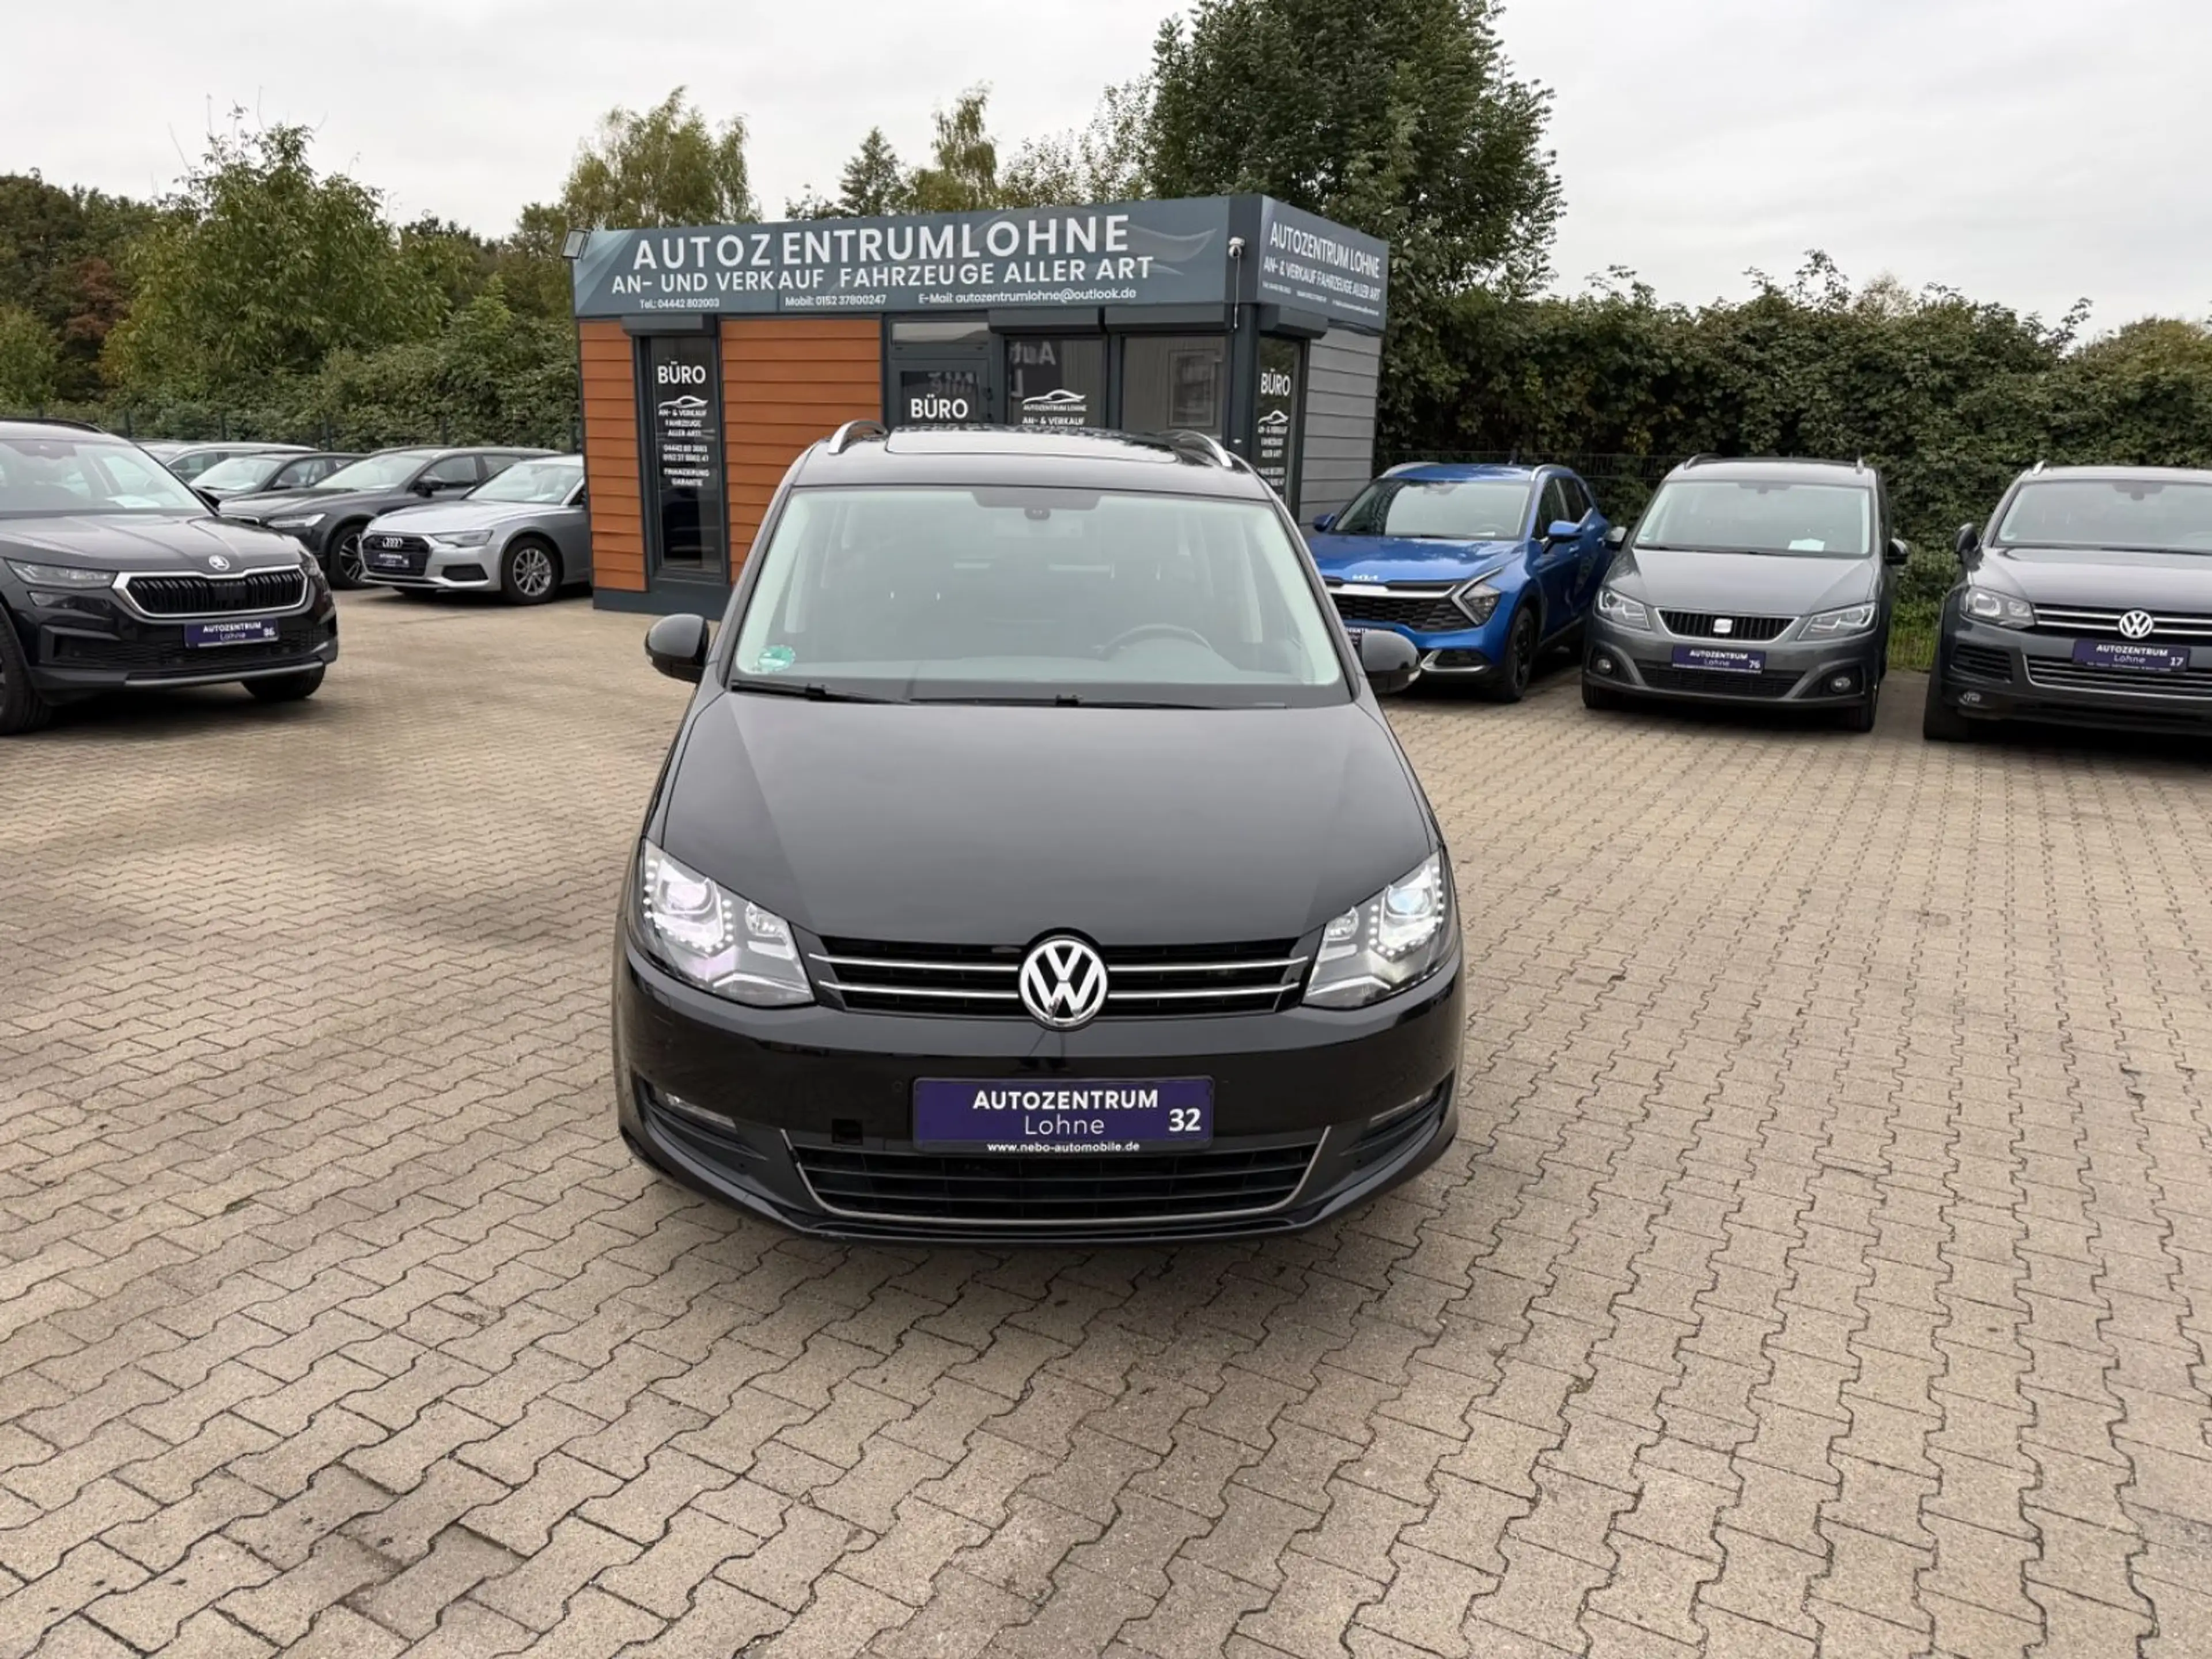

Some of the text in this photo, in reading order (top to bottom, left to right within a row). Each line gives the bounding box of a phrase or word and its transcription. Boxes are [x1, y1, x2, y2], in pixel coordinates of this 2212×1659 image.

[1270, 221, 1380, 279] AUTOZENTRUM LOHNE
[611, 256, 1154, 294] AN- UND VERKAUF FAHRZEUGE ALLER ART
[815, 296, 837, 306] 0152
[955, 287, 1136, 304] autozentrumlohne@outlook.de
[657, 361, 706, 384] BÜRO
[1260, 368, 1290, 396] BÜRO
[910, 393, 969, 419] BÜRO
[1048, 416, 1085, 425] VERKAUF
[203, 621, 262, 634] AUTOZENTRUM
[1689, 649, 1748, 660] AUTOZENTRUM
[2096, 644, 2168, 657] AUTOZENTRUM
[2113, 654, 2146, 664] Lohne
[2170, 656, 2184, 667] 17
[972, 1089, 1158, 1111] AUTOZENTRUM
[1025, 1108, 1202, 1135] Lohne 32
[986, 1141, 1140, 1152] www.nebo-automobile.de
